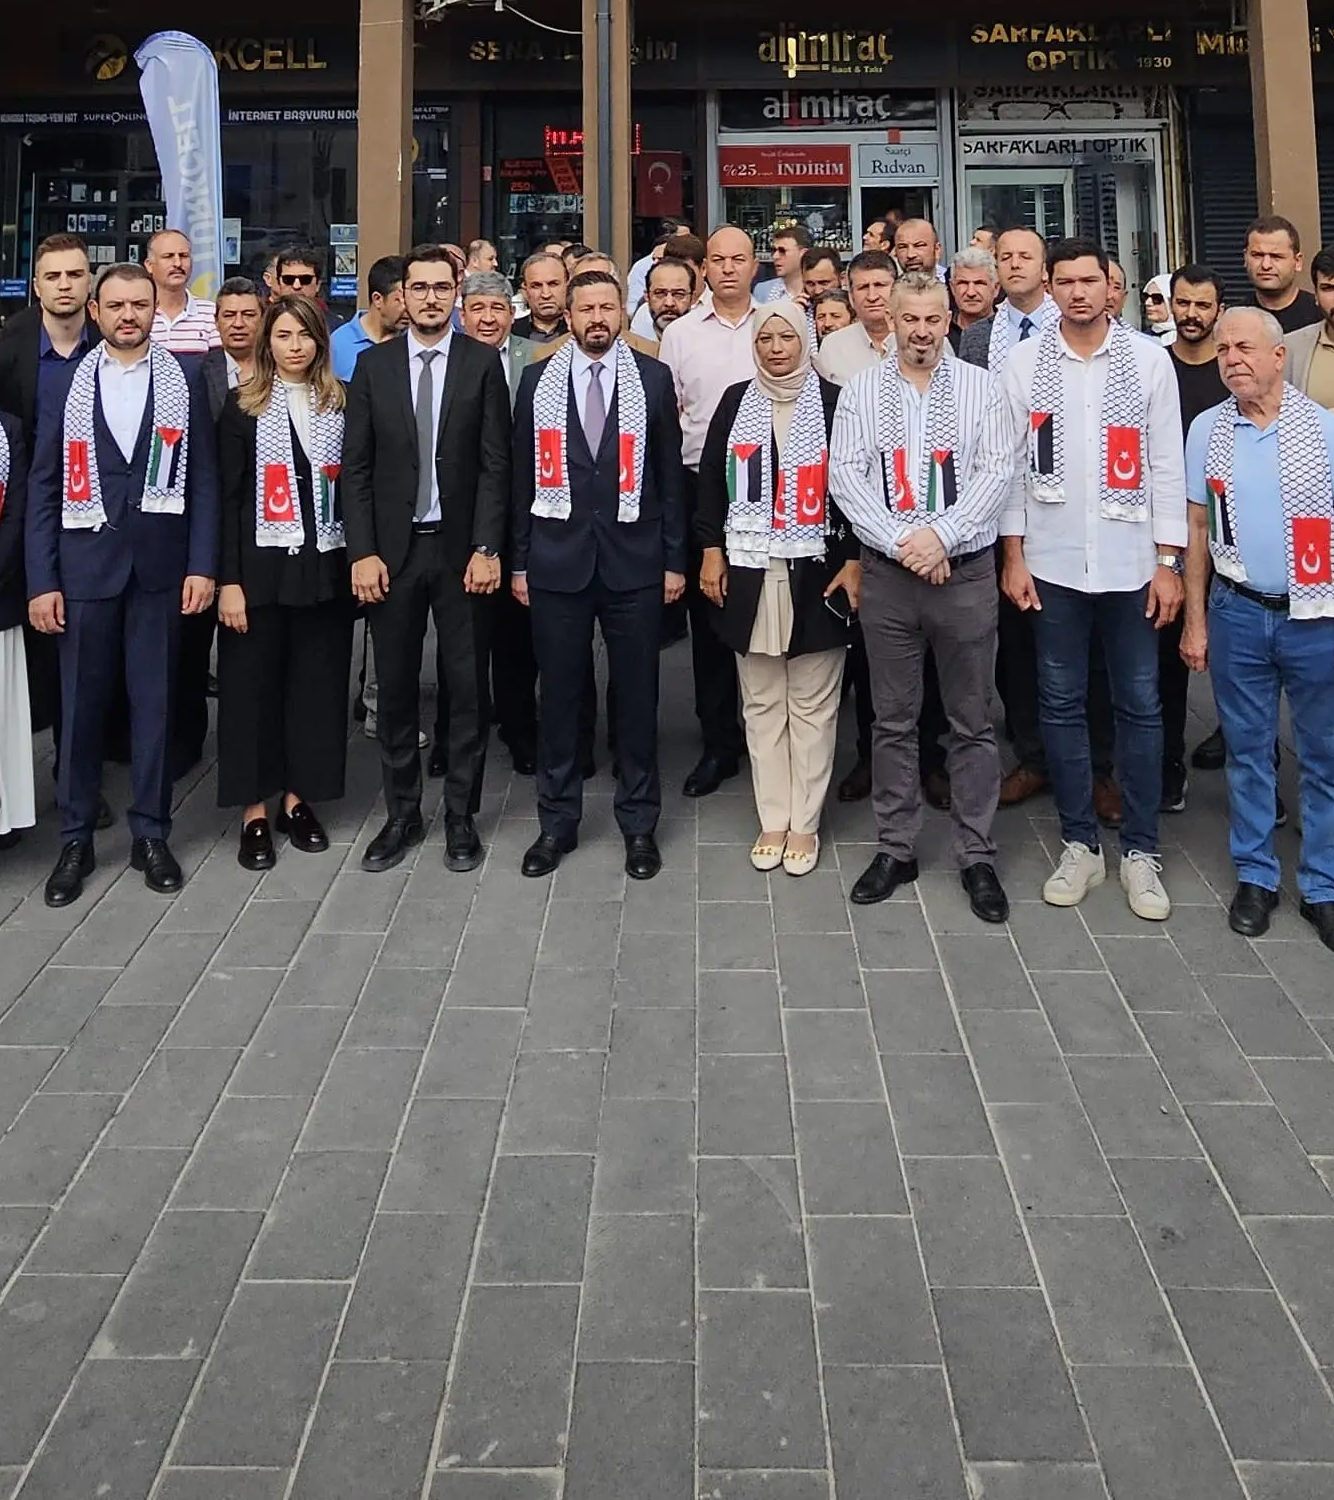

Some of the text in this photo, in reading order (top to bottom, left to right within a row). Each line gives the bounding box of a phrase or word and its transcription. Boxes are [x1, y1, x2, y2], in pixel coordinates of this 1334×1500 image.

[1137, 57, 1172, 69] 1930
[228, 108, 282, 122] İNTERNET
[283, 109, 335, 123] BAŞVURU
[722, 160, 844, 177] %25 İNDİRİM
[871, 158, 926, 175] Rıdvan
